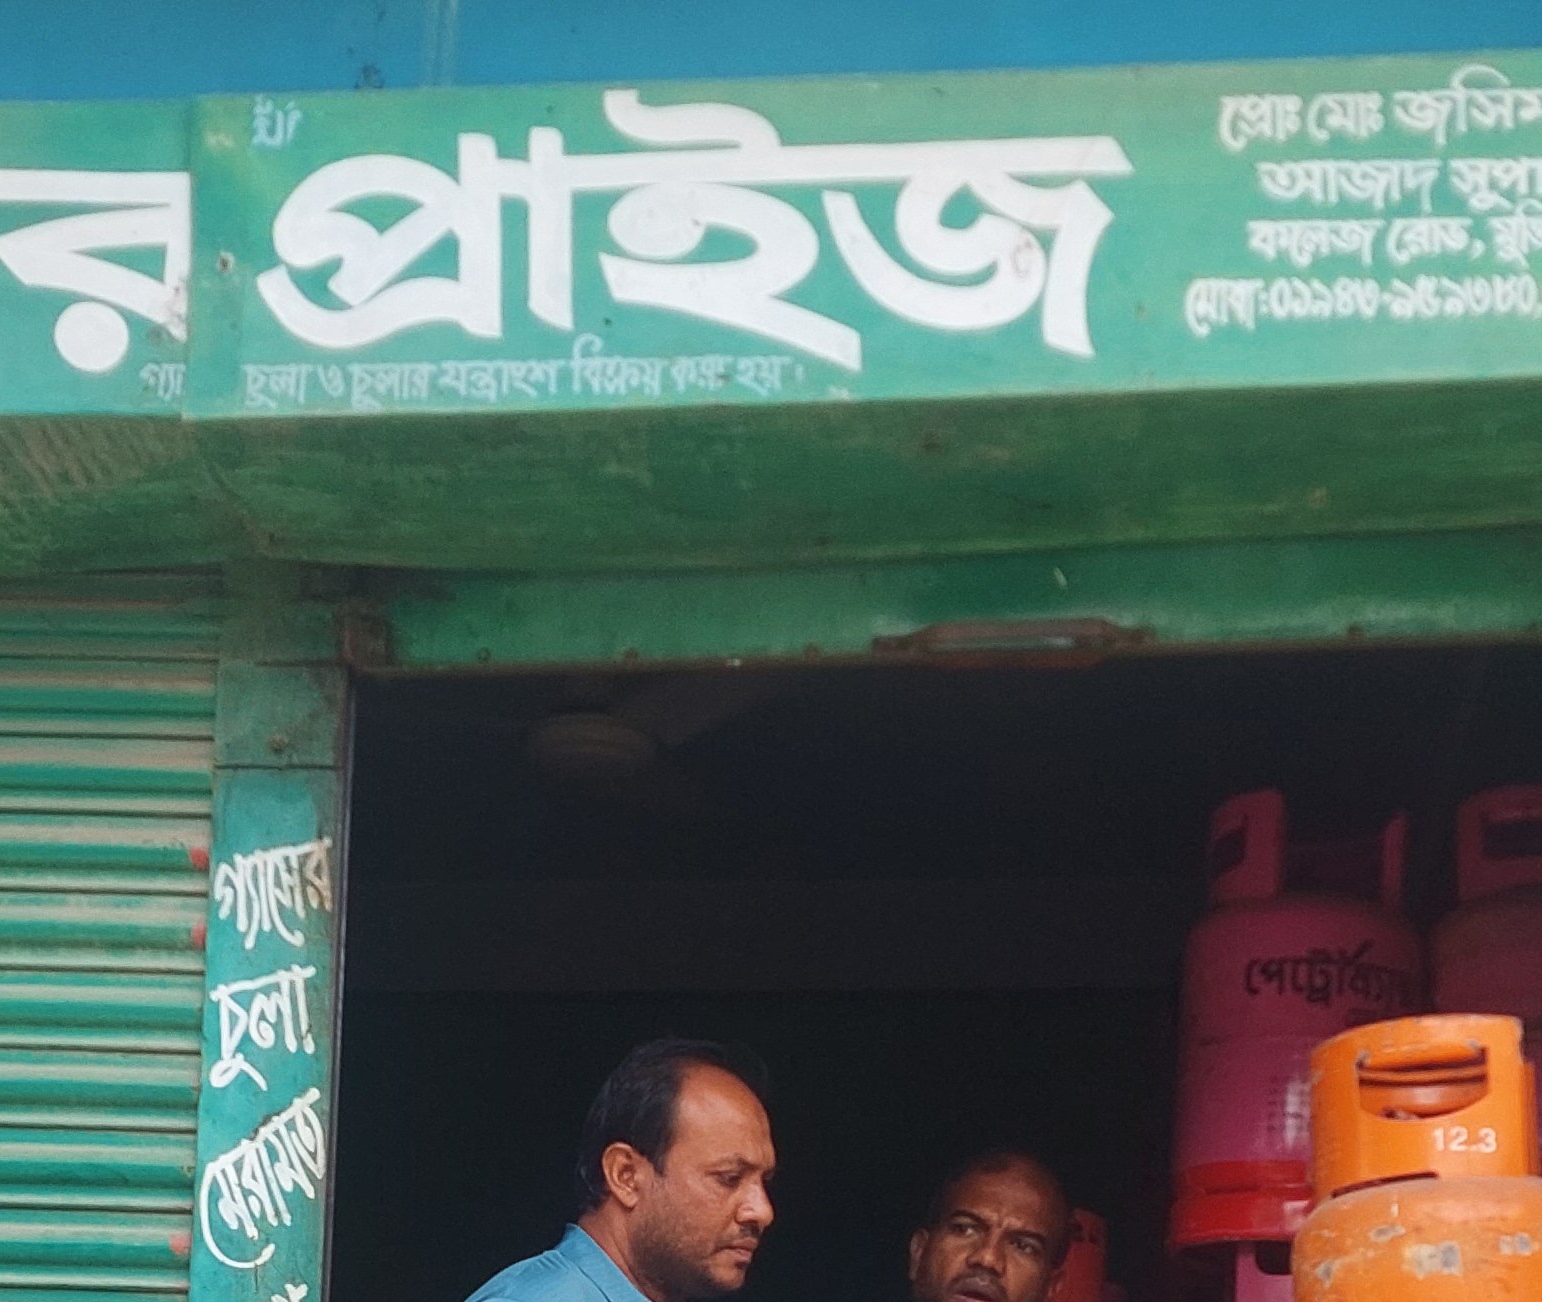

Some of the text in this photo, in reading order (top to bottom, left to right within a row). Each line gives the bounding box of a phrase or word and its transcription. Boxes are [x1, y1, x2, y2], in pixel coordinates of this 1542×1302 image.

[1255, 156, 1440, 213] আজাদ
[256, 88, 1134, 371] প্রাইজ
[1247, 219, 1386, 268] কলেজ
[315, 364, 346, 399] ও
[214, 837, 332, 949] গ্যাসের
[209, 965, 317, 1091] চুলা
[200, 1087, 326, 1269] মেরামত
[1432, 1127, 1498, 1155] 12.3
